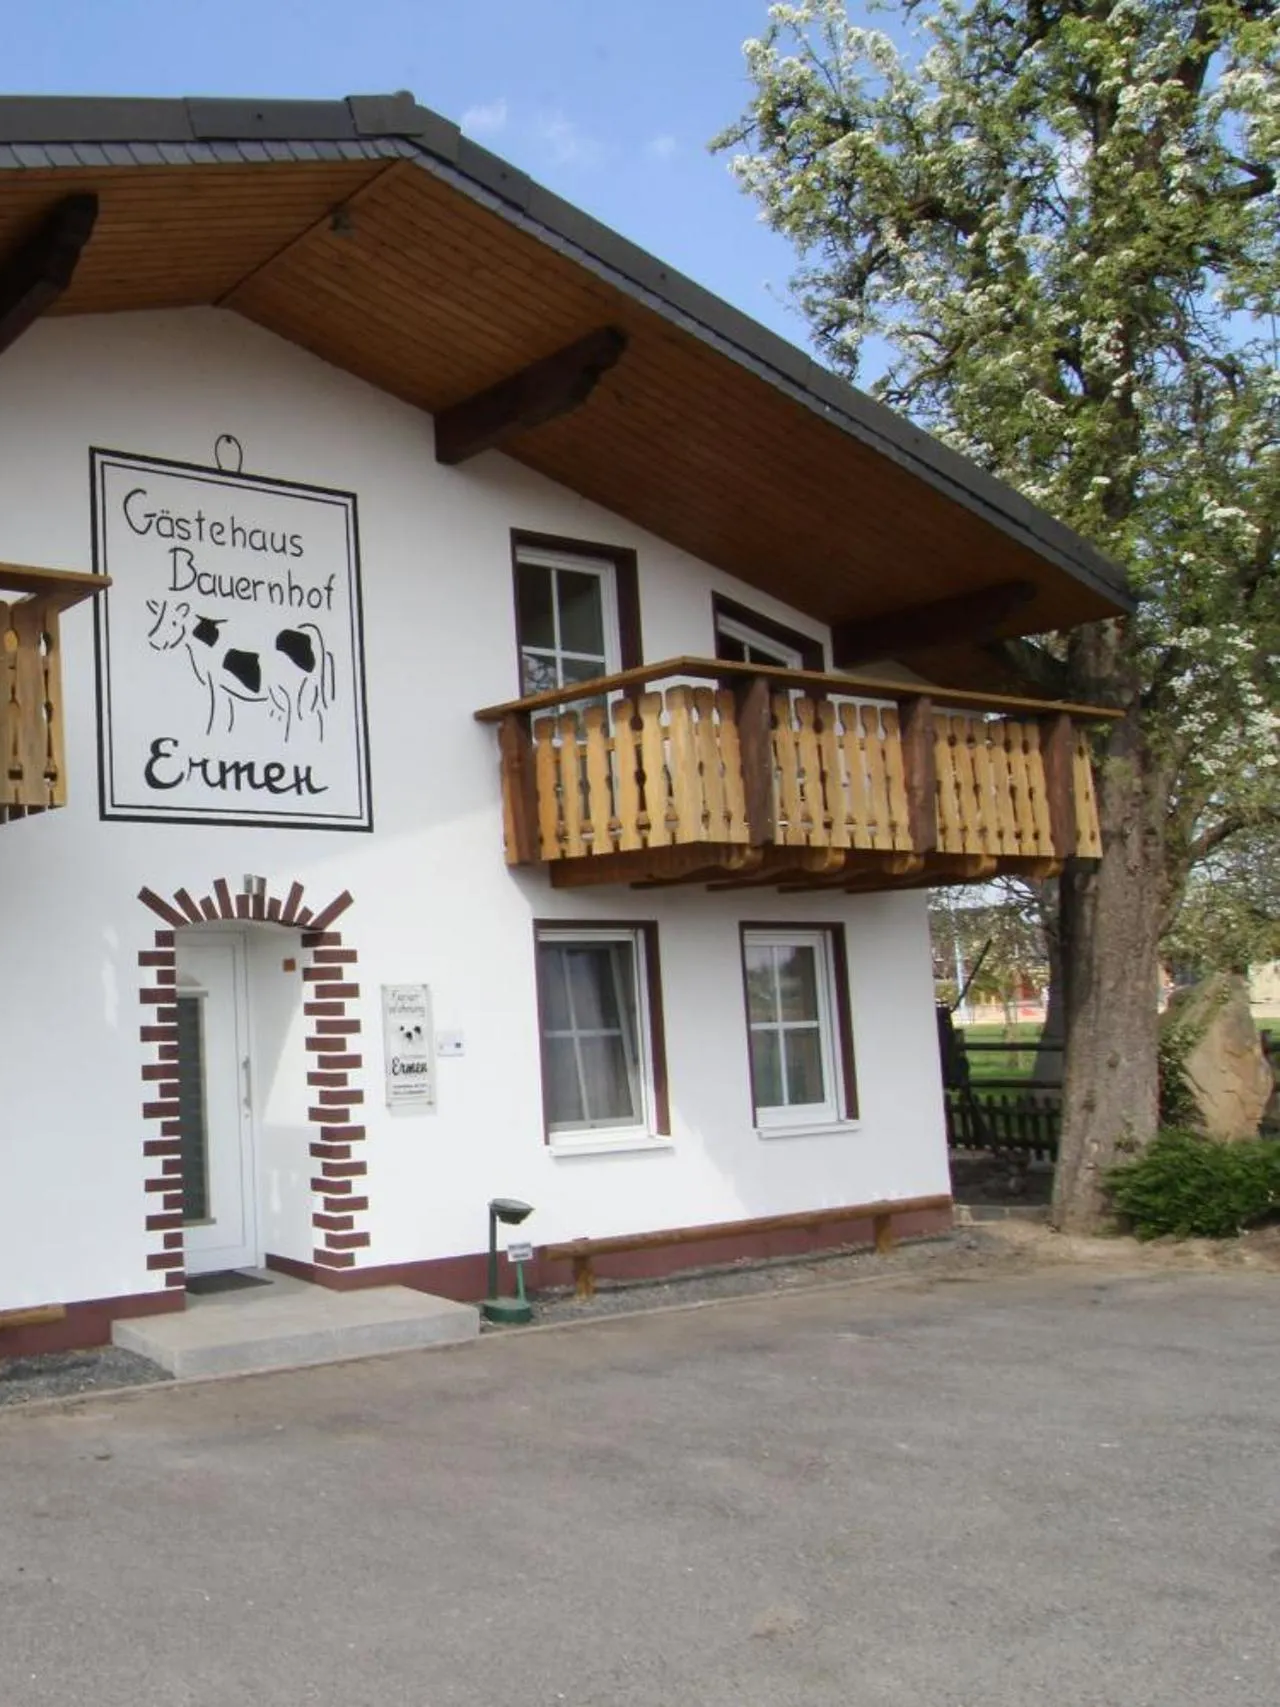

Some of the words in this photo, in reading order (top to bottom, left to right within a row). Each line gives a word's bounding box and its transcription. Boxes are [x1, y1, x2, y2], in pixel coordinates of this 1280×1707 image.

[123, 488, 304, 557] Gästehaus
[168, 547, 336, 610] Bauernhof
[144, 737, 328, 796] Ermen
